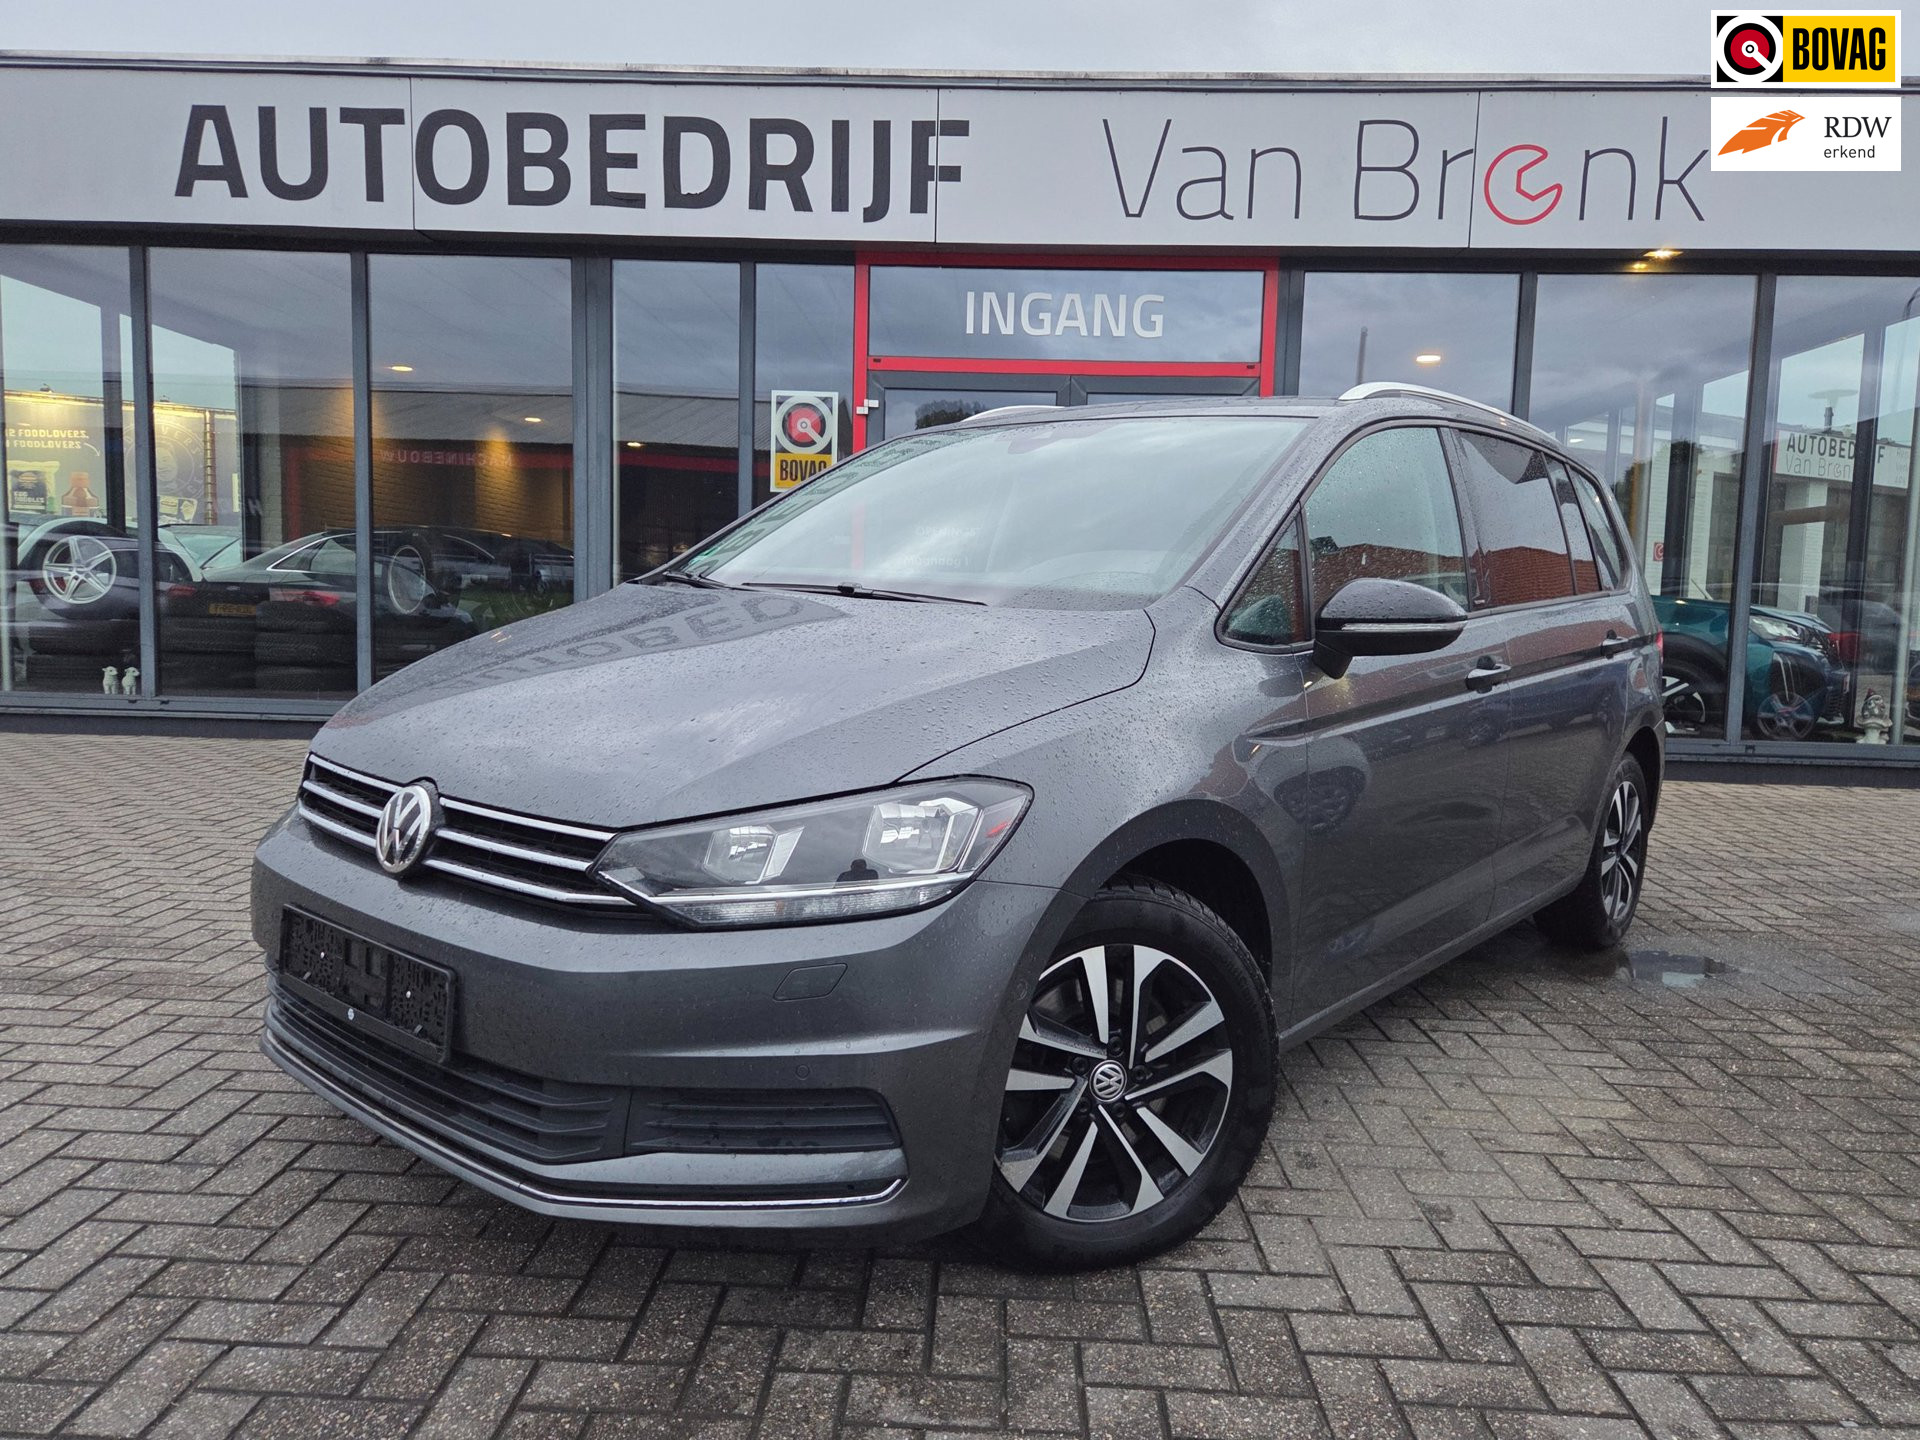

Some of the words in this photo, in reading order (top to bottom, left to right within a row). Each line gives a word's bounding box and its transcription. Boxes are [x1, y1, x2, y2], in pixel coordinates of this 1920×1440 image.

[174, 104, 970, 223] AUTOBEDRIJF
[1102, 118, 1302, 221] Van
[965, 291, 1165, 338] INGANG
[1785, 453, 1811, 475] Van
